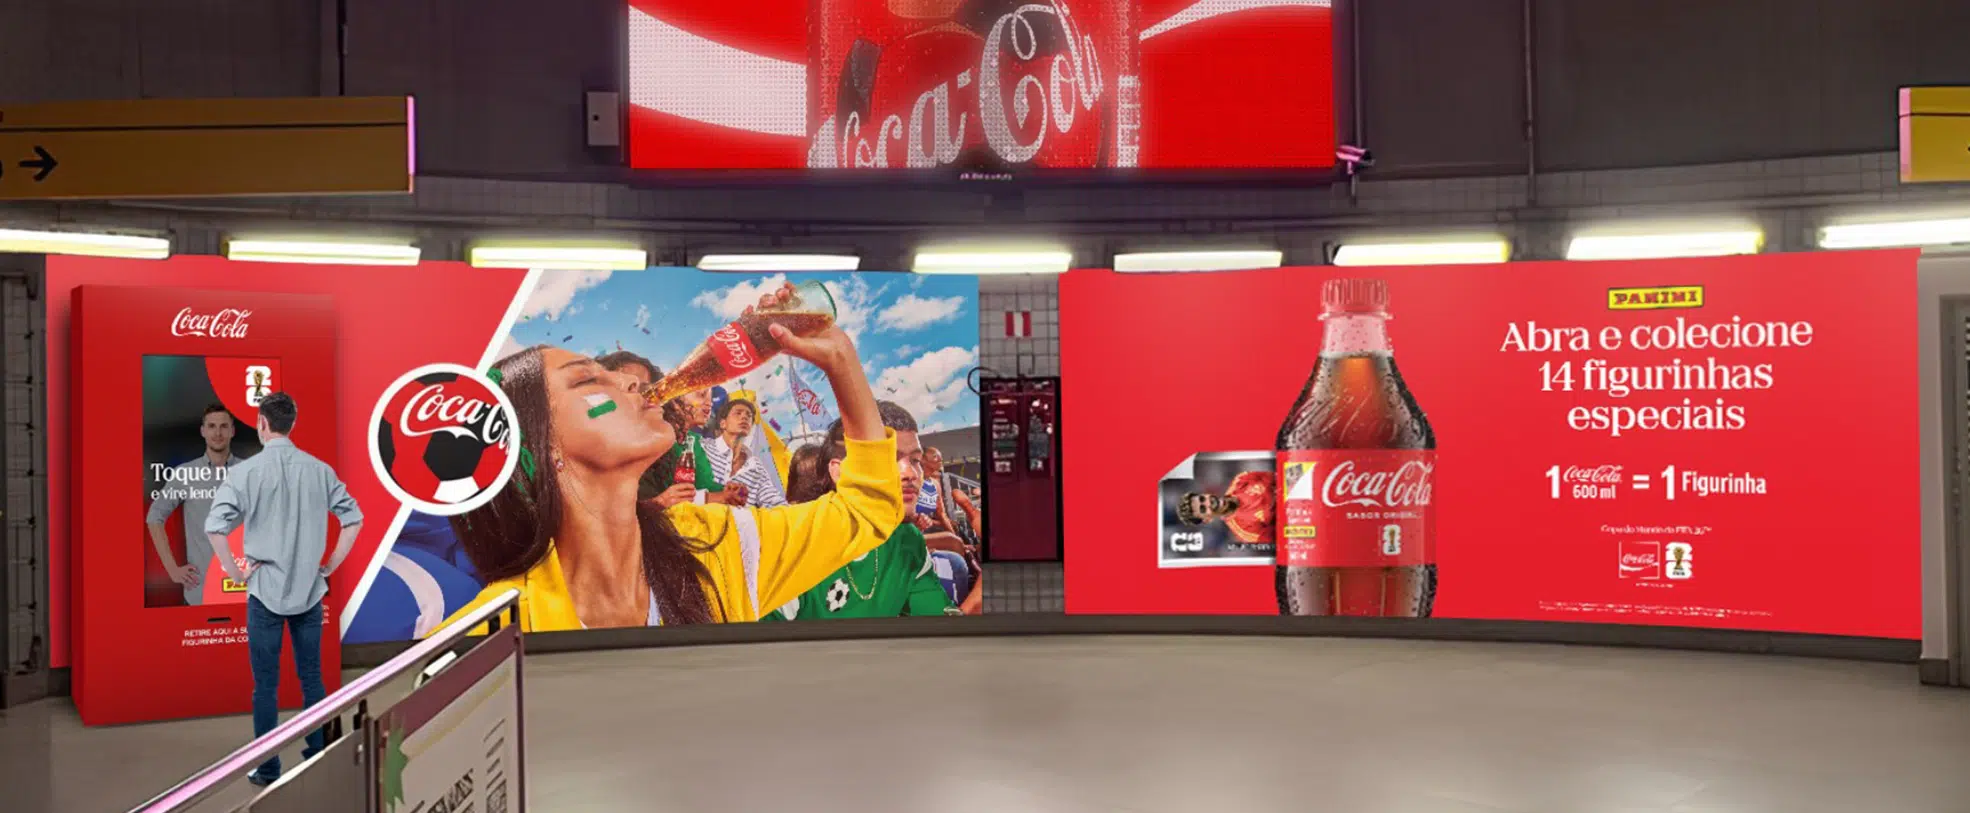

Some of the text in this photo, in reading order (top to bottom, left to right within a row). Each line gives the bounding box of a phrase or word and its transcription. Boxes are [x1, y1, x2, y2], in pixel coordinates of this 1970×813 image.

[1613, 290, 1698, 305] PANINI
[171, 307, 252, 338] Coca-Cola
[1500, 316, 1813, 351] Abra e colecione
[1538, 357, 1774, 397] 14 figurinhas
[1567, 398, 1746, 436] especiais
[150, 463, 211, 485] Toque
[1322, 461, 1433, 507] Coca-Cola
[1546, 465, 1560, 498] 1
[1563, 465, 1624, 483] Coca-Cola
[1661, 465, 1675, 500] 1
[1682, 471, 1767, 497] Figurinha
[151, 487, 218, 499] e vire lend
[1572, 485, 1616, 499] 600 ml
[184, 629, 211, 637] RETIRE
[225, 636, 236, 644] DA
